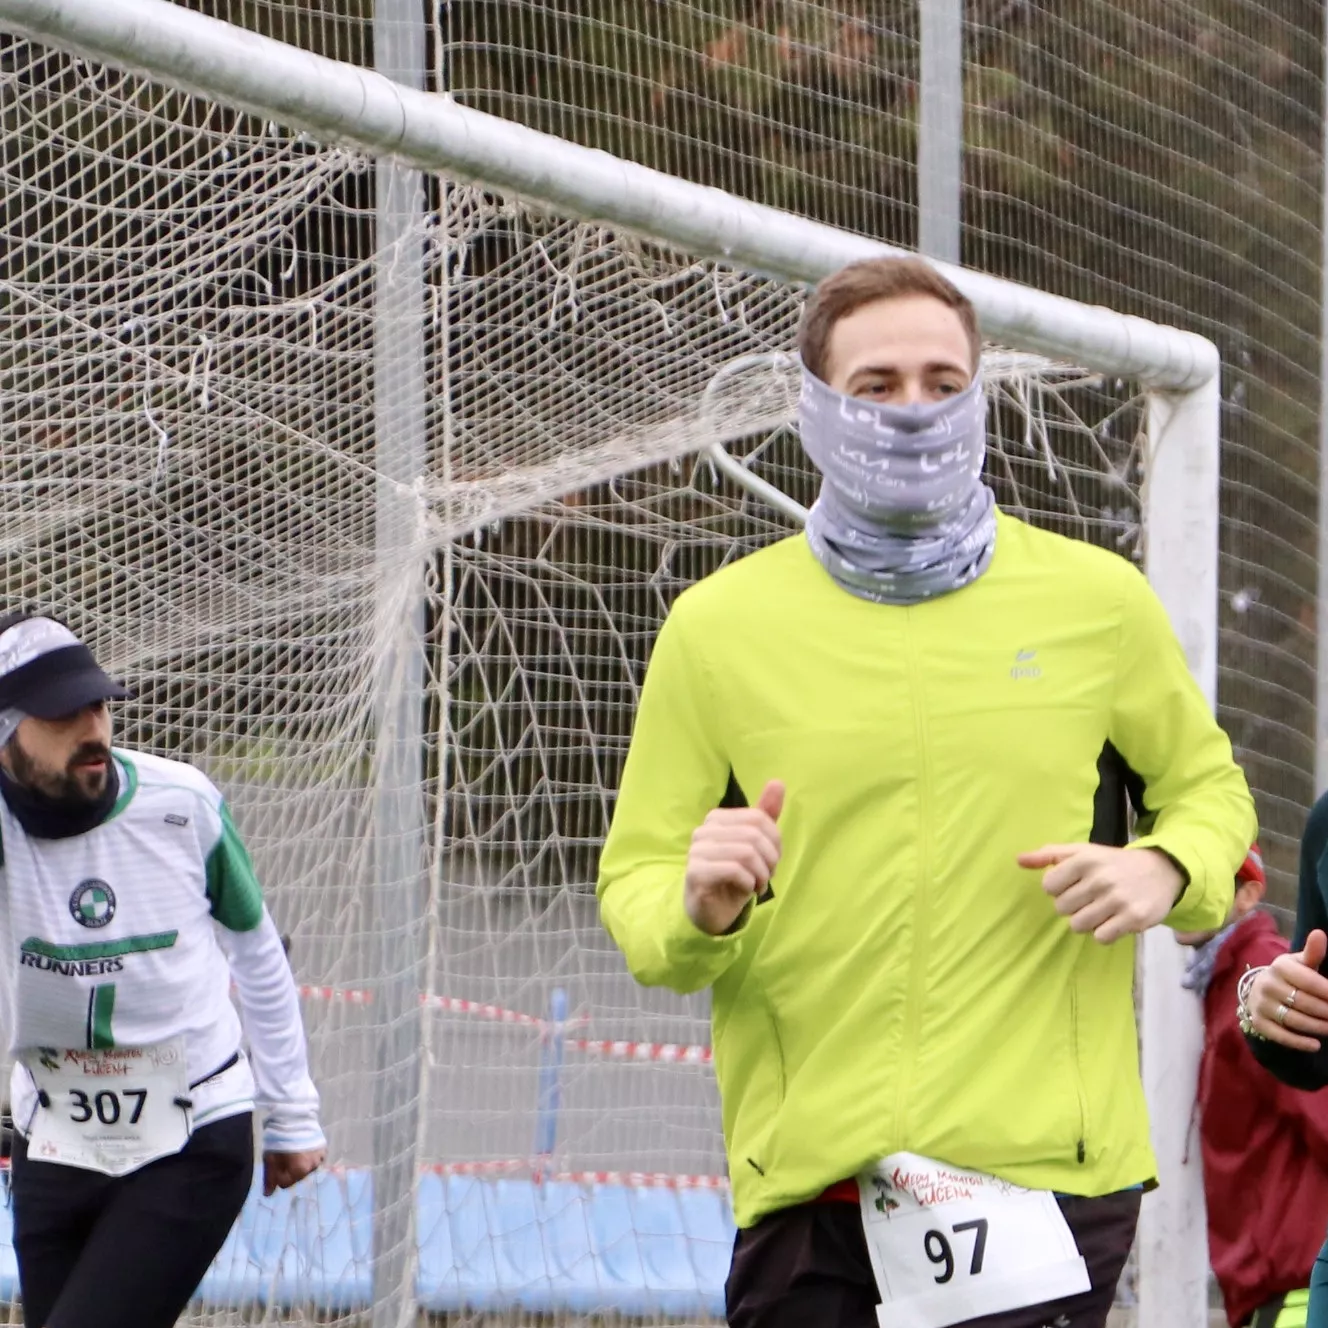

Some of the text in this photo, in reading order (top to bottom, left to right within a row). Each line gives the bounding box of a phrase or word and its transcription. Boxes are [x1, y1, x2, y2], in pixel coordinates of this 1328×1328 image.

[876, 473, 907, 488] Cars
[20, 951, 124, 977] RUNNERS
[69, 1088, 148, 1125] 307
[912, 1184, 972, 1207] LUCENA
[923, 1216, 990, 1285] 97
